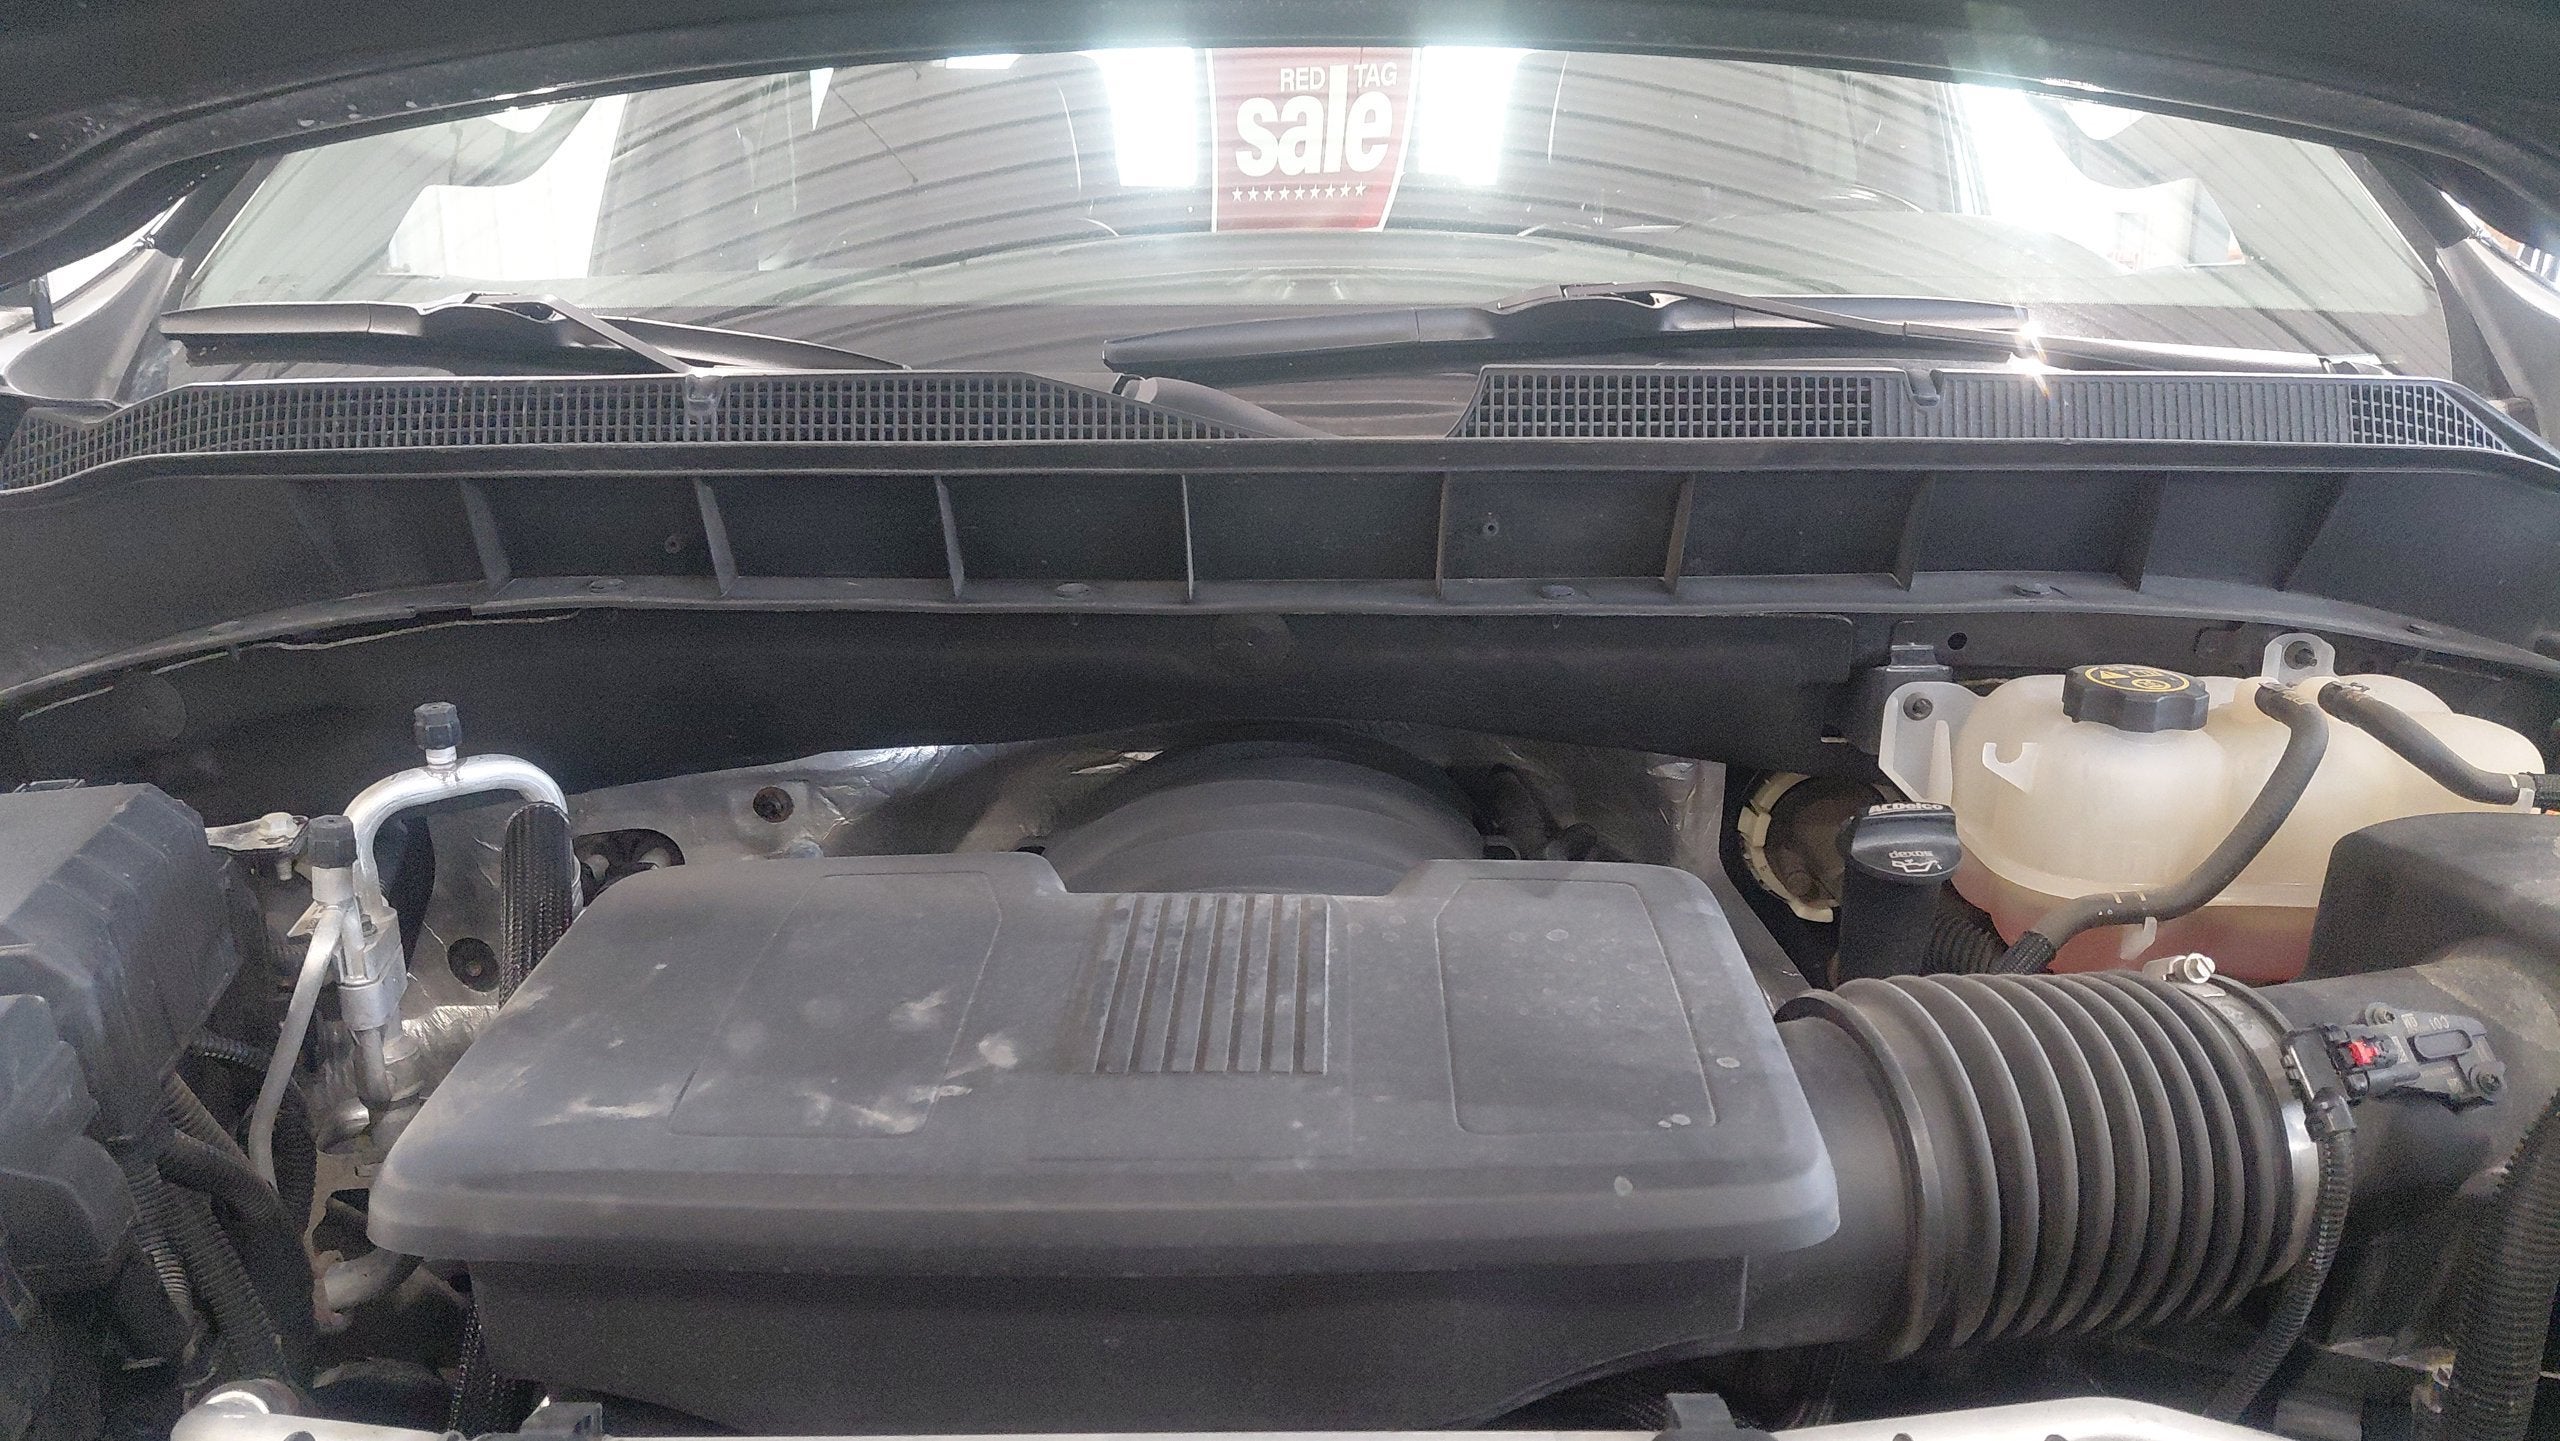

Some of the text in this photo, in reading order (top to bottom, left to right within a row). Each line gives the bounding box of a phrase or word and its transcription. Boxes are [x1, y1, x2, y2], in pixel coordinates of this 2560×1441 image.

[1280, 61, 1398, 92] RED TAG
[1235, 64, 1393, 177] sale
[1868, 802, 1943, 815] ACDelco
[1888, 850, 1934, 859] dexos
